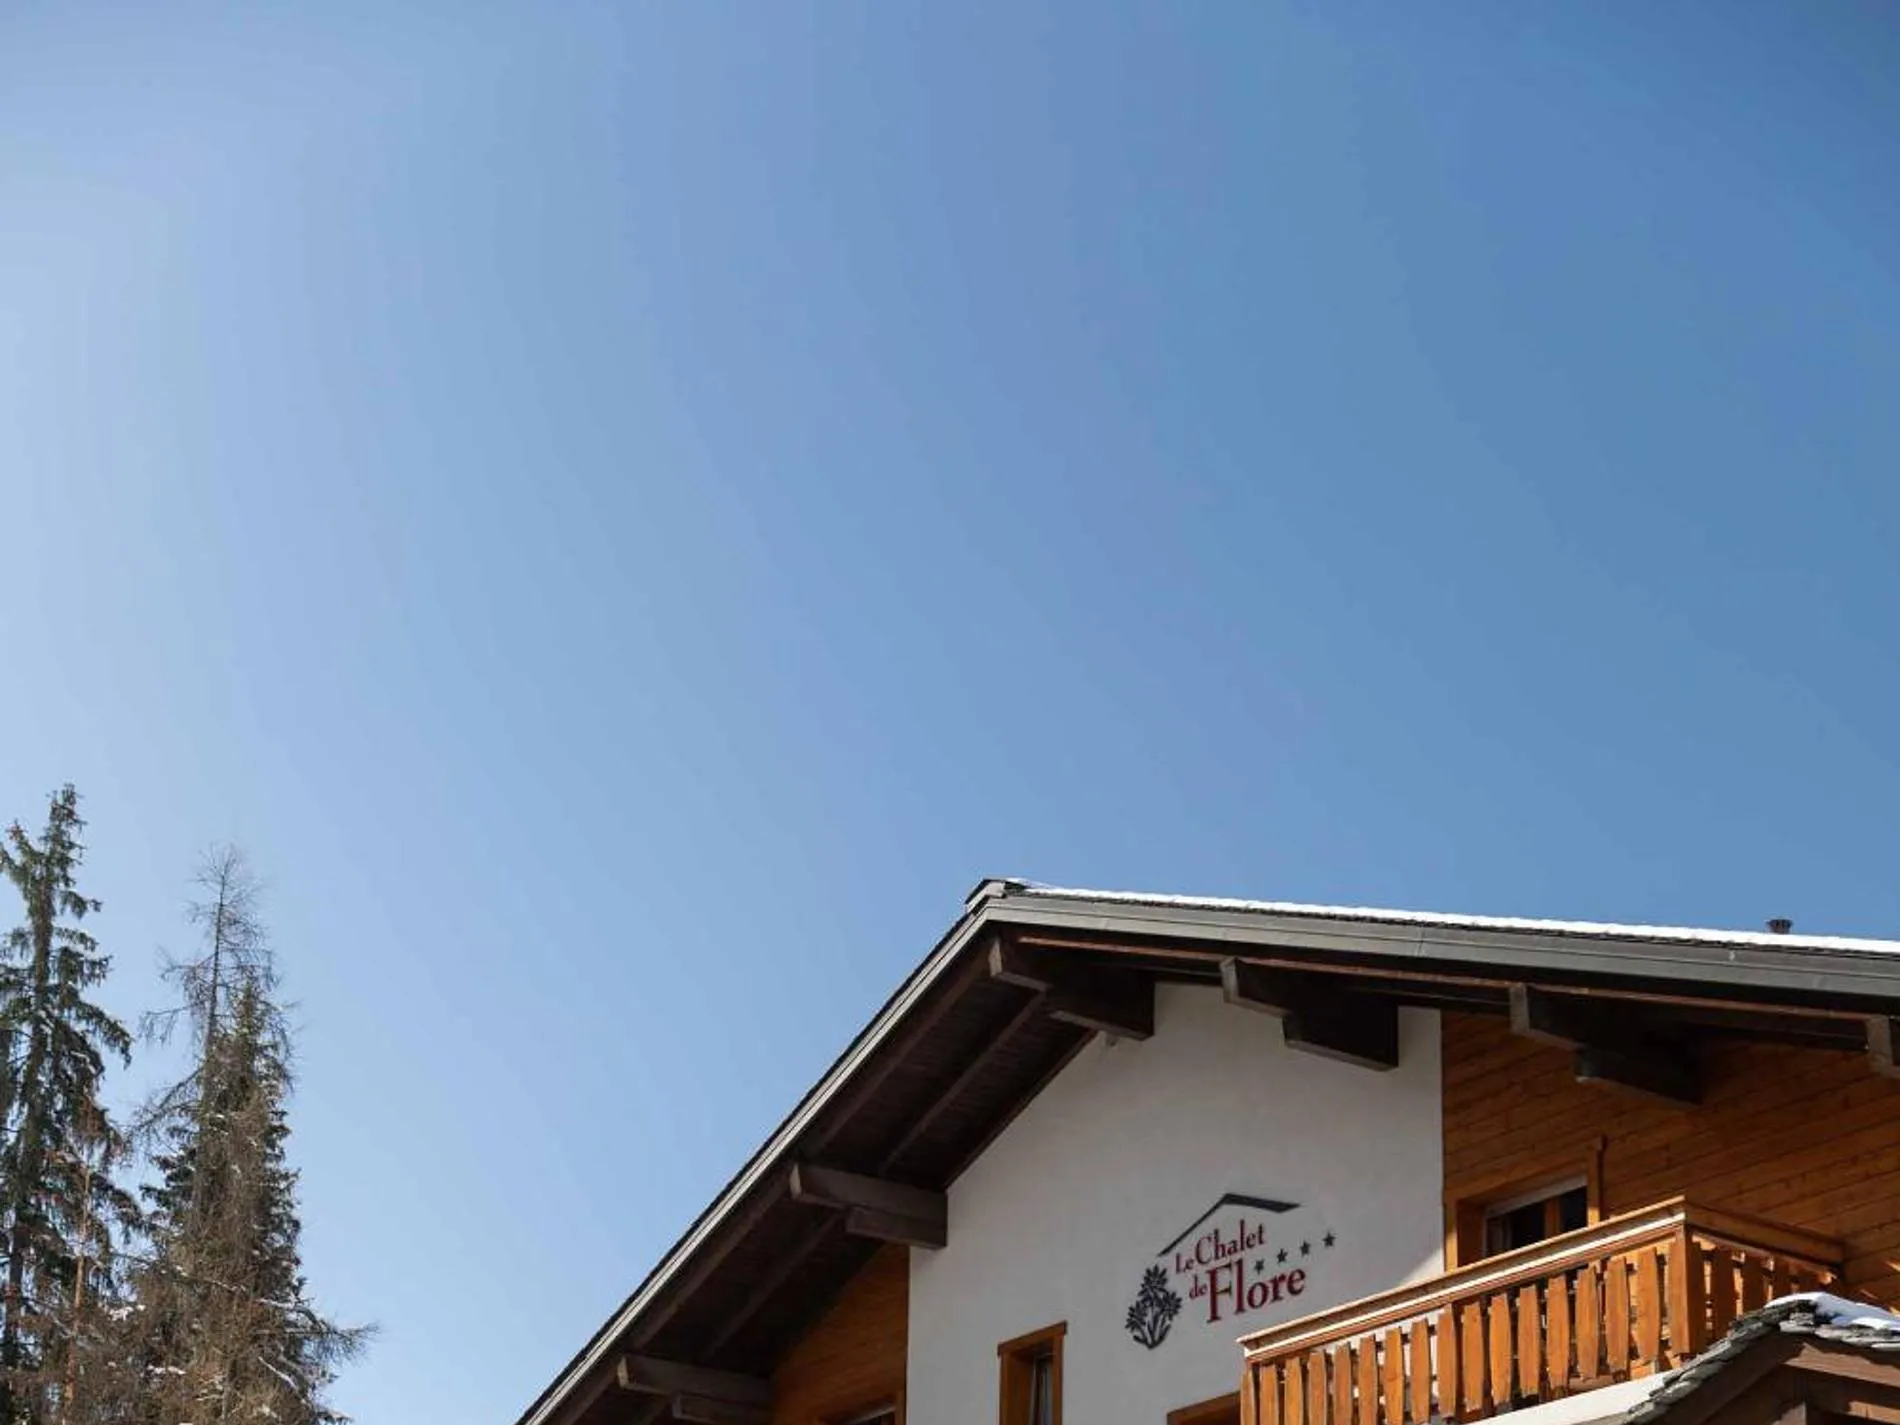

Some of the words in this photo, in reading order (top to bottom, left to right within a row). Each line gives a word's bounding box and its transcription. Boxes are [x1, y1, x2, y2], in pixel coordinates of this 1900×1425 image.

[1175, 1252, 1195, 1274] Le
[1195, 1218, 1266, 1265] Chalet
[1188, 1275, 1208, 1300] de
[1206, 1258, 1306, 1324] Flore
